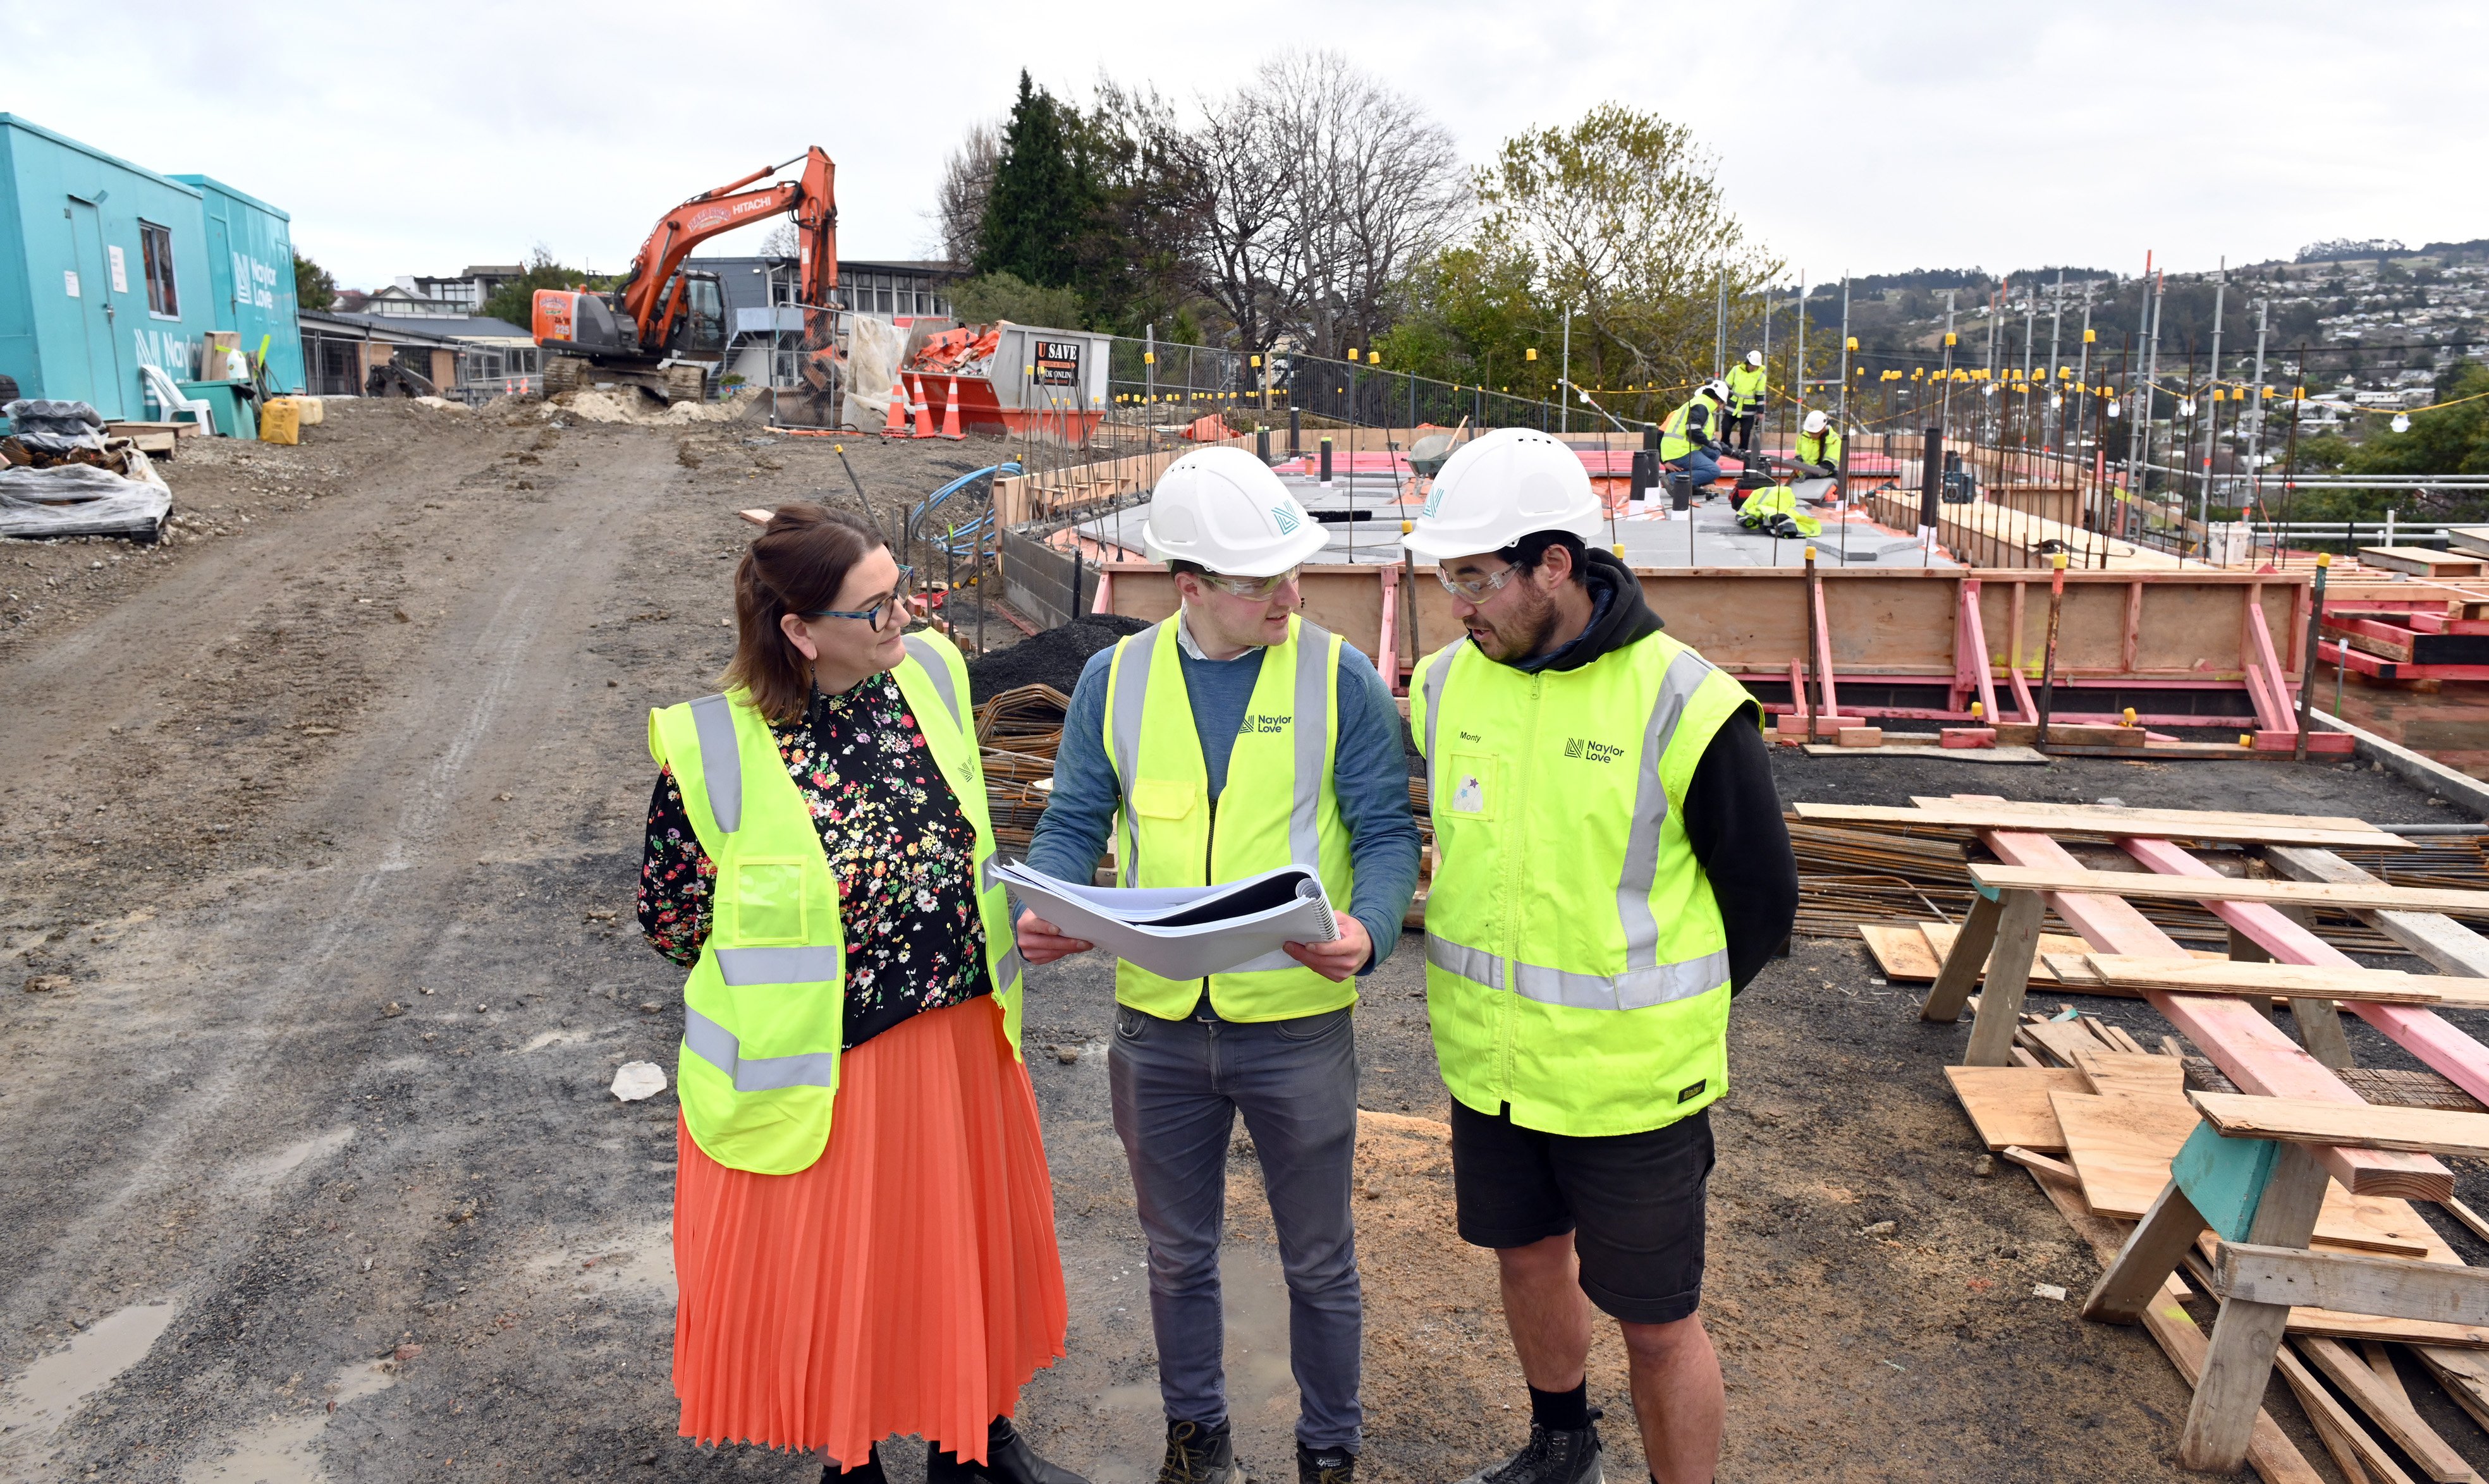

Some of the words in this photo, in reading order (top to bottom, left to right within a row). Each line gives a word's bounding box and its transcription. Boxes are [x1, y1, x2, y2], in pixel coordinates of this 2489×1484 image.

[733, 196, 771, 215] HITACHI
[250, 257, 277, 289] Naylor
[253, 282, 272, 309] Love
[1038, 343, 1046, 358] U
[1049, 343, 1077, 360] SAVE
[1054, 370, 1072, 379] ONLIN
[1258, 714, 1292, 726] Naylor
[1258, 723, 1281, 733] Love
[1460, 731, 1481, 743] Monty
[1587, 740, 1624, 757] Naylor
[1586, 750, 1611, 763] Love
[1684, 1085, 1703, 1098] Bisley
